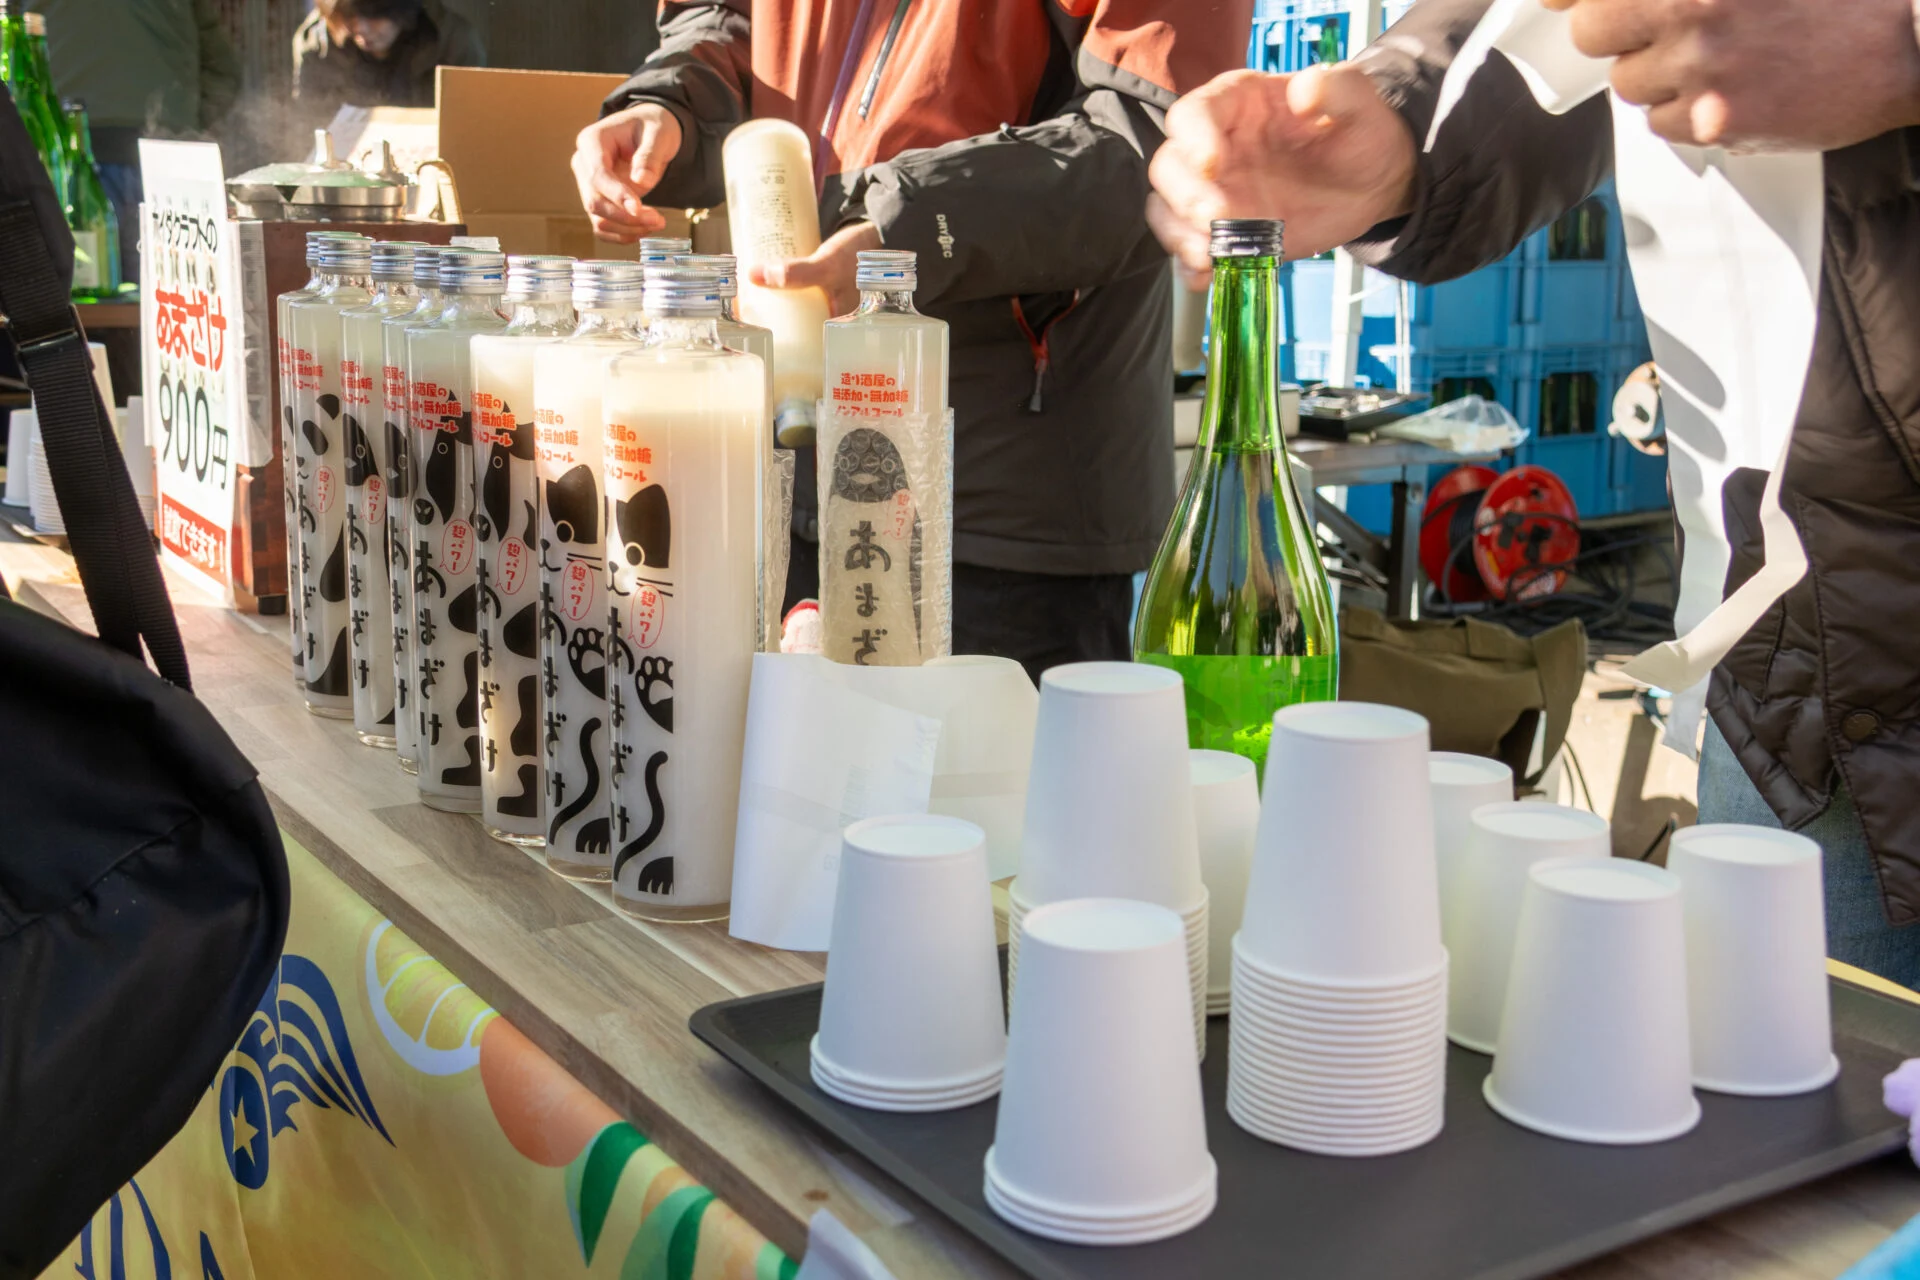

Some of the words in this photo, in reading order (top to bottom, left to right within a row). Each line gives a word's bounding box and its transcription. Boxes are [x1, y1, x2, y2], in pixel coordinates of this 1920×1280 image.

[155, 280, 228, 371] あまざけ
[159, 372, 229, 490] 900円
[833, 387, 909, 403] 無添加・無加糖
[836, 404, 904, 418] ノンアルコール
[841, 371, 895, 387] 造り酒屋の
[414, 540, 446, 746] あまざけ
[476, 558, 502, 773] あまざけ
[540, 582, 567, 807] あまざけ
